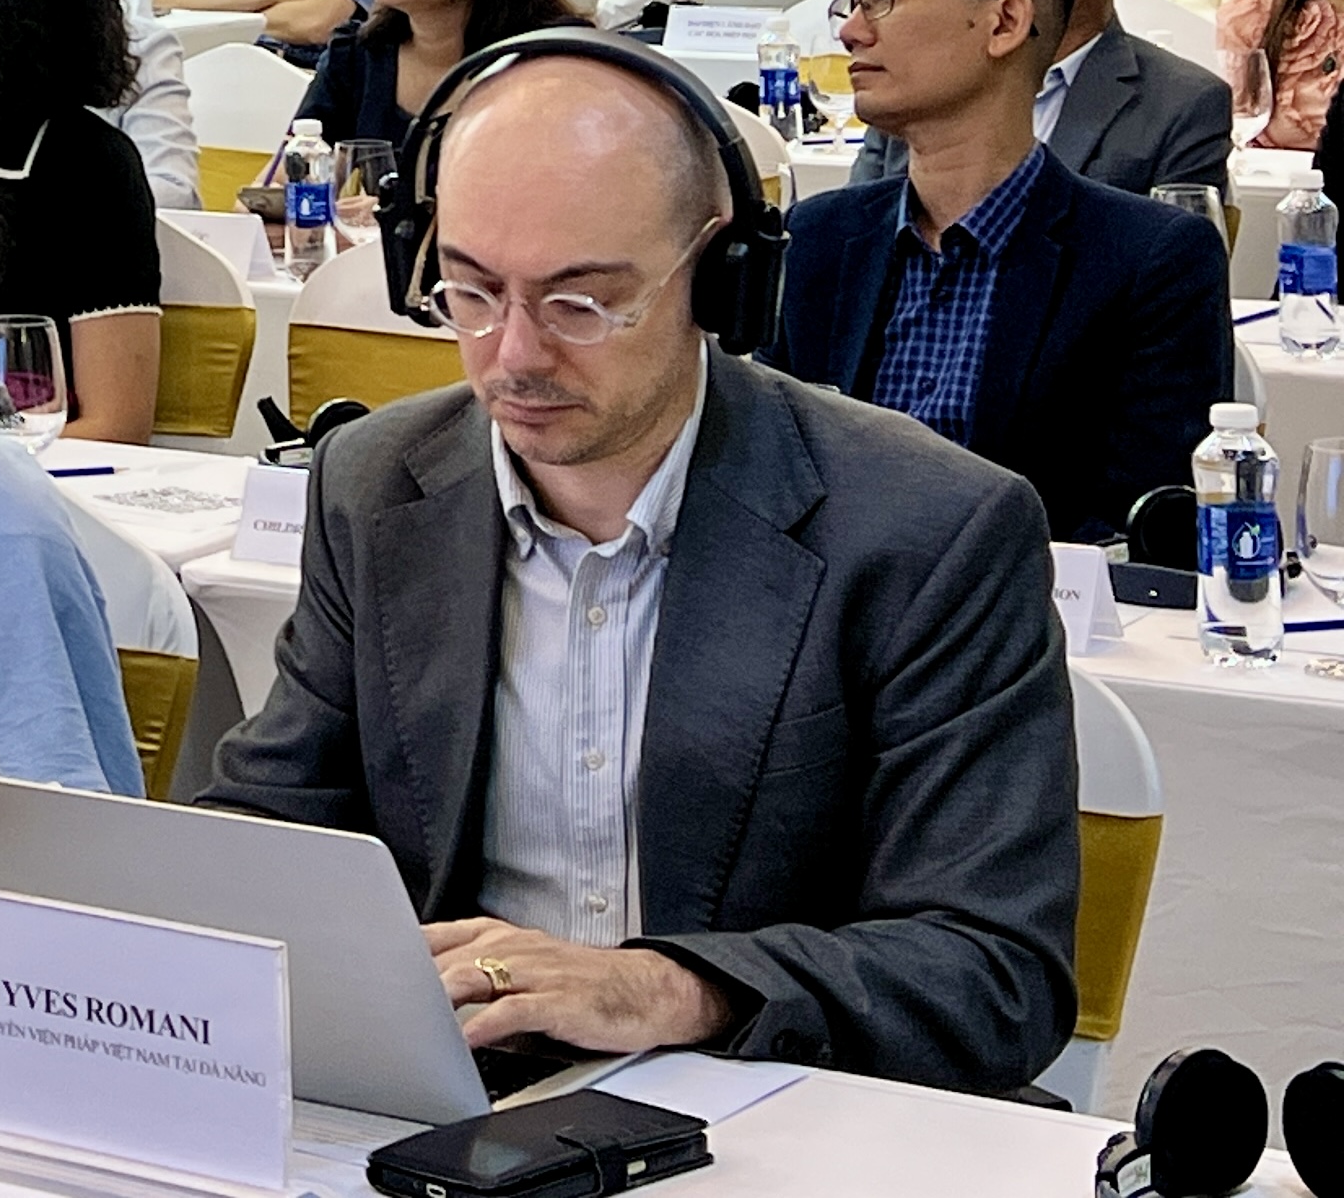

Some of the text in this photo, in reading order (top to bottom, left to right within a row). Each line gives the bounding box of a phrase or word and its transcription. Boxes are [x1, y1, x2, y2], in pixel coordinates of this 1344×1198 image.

[2, 979, 78, 1019] YVES
[85, 995, 210, 1046] ROMANI
[136, 1048, 170, 1068] NAM
